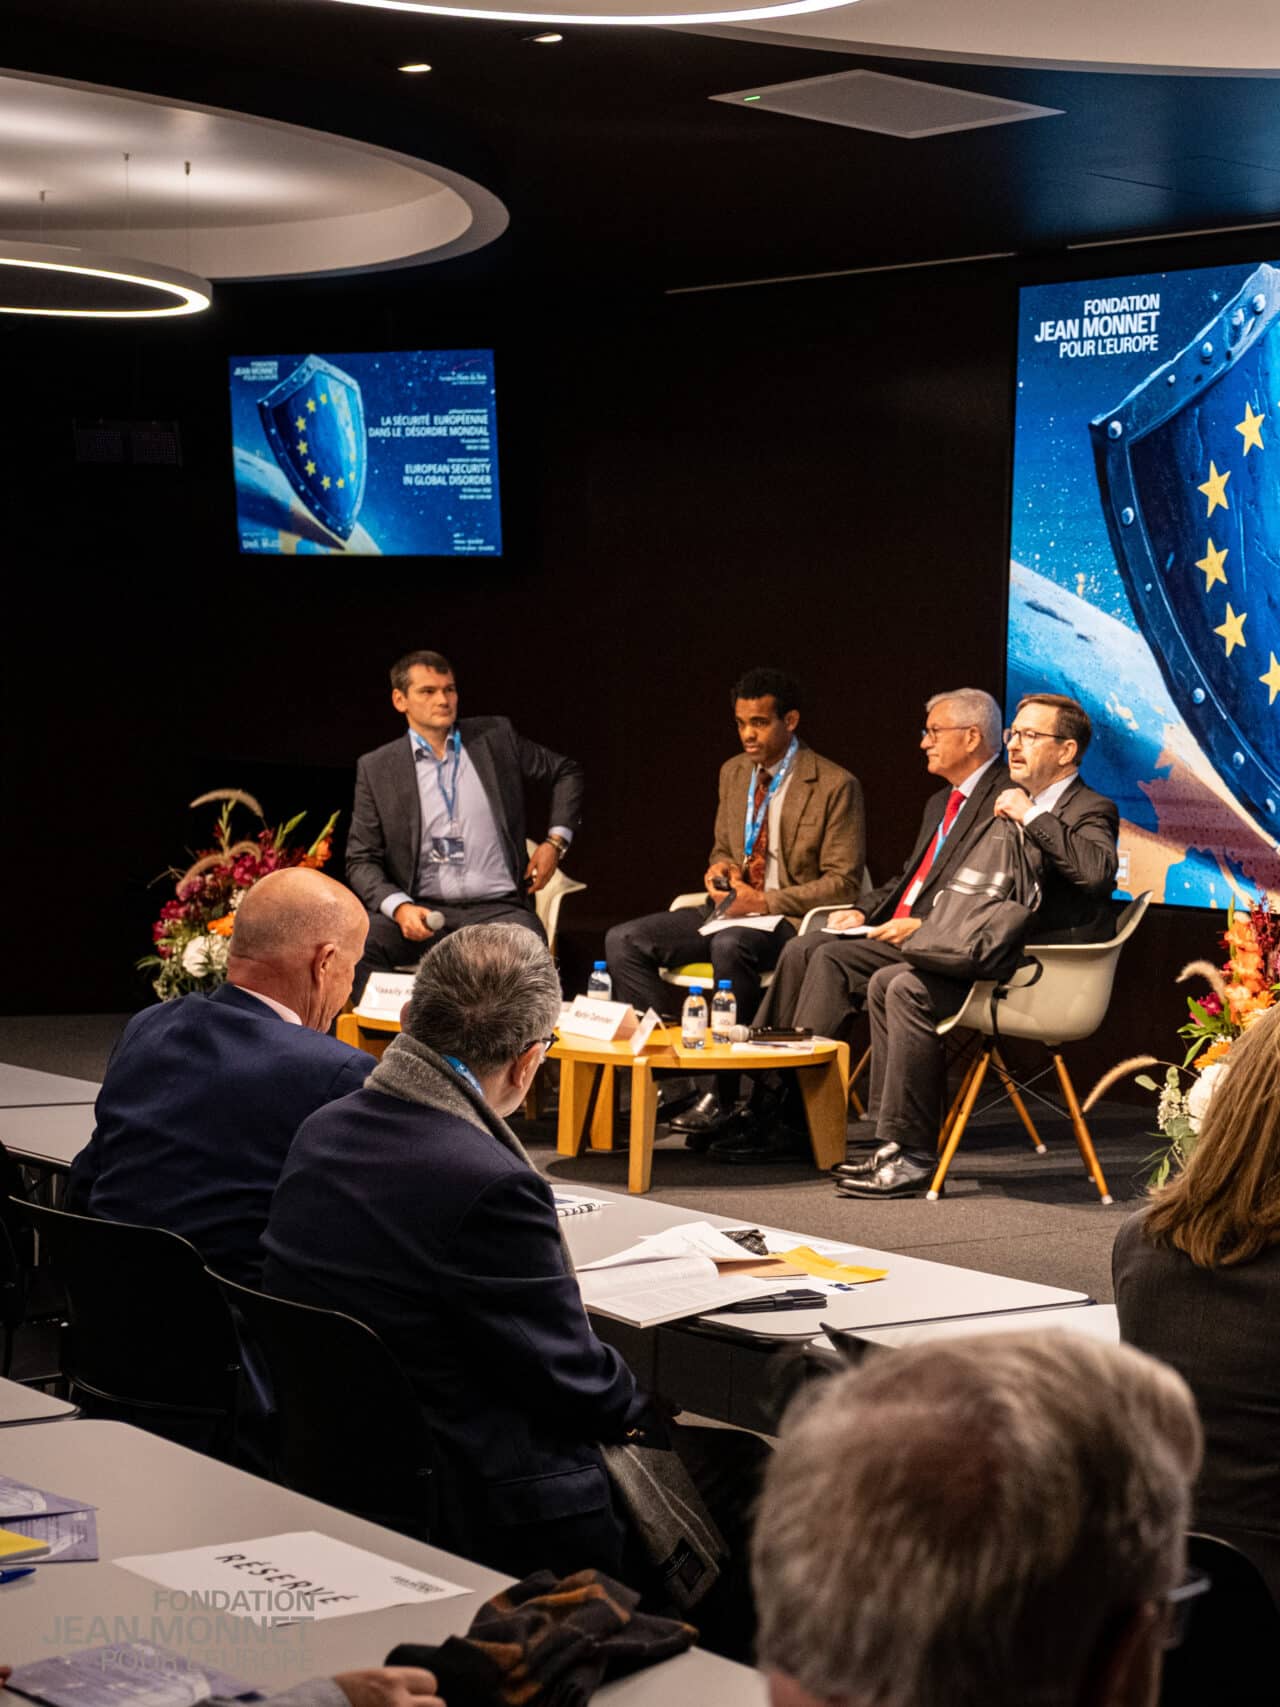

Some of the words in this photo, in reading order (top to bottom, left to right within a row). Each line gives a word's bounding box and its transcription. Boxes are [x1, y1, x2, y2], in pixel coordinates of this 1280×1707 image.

[1083, 293, 1160, 316] FONDATION
[1034, 319, 1080, 343] JEAN
[1082, 311, 1160, 338] MONNET
[1060, 340, 1096, 358] POUR
[1098, 334, 1159, 355] L'EUROPE
[214, 1553, 359, 1604] RÉSERVÉ
